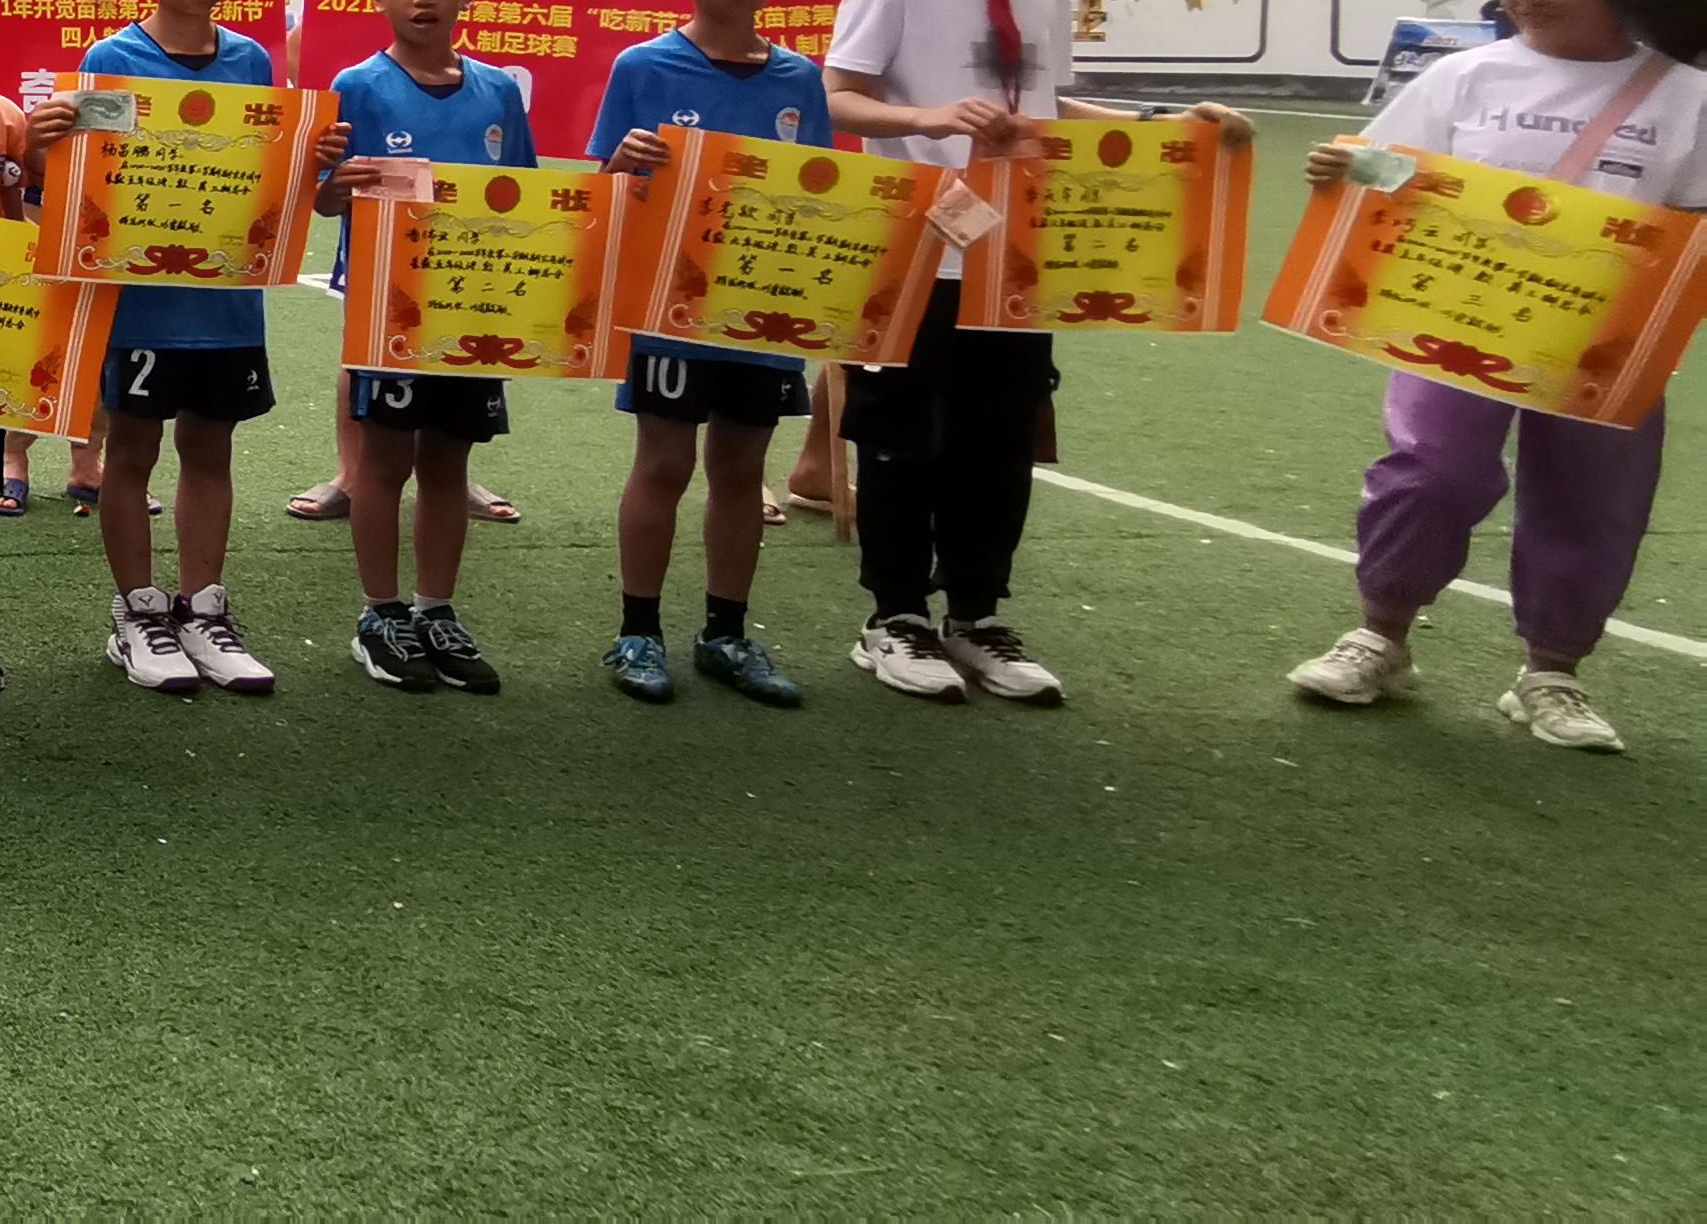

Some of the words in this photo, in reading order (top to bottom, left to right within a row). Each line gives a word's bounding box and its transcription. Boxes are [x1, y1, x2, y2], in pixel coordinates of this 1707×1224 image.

[452, 31, 578, 59] 人制足球赛
[1479, 105, 1657, 146] Huned
[128, 349, 156, 398] 2
